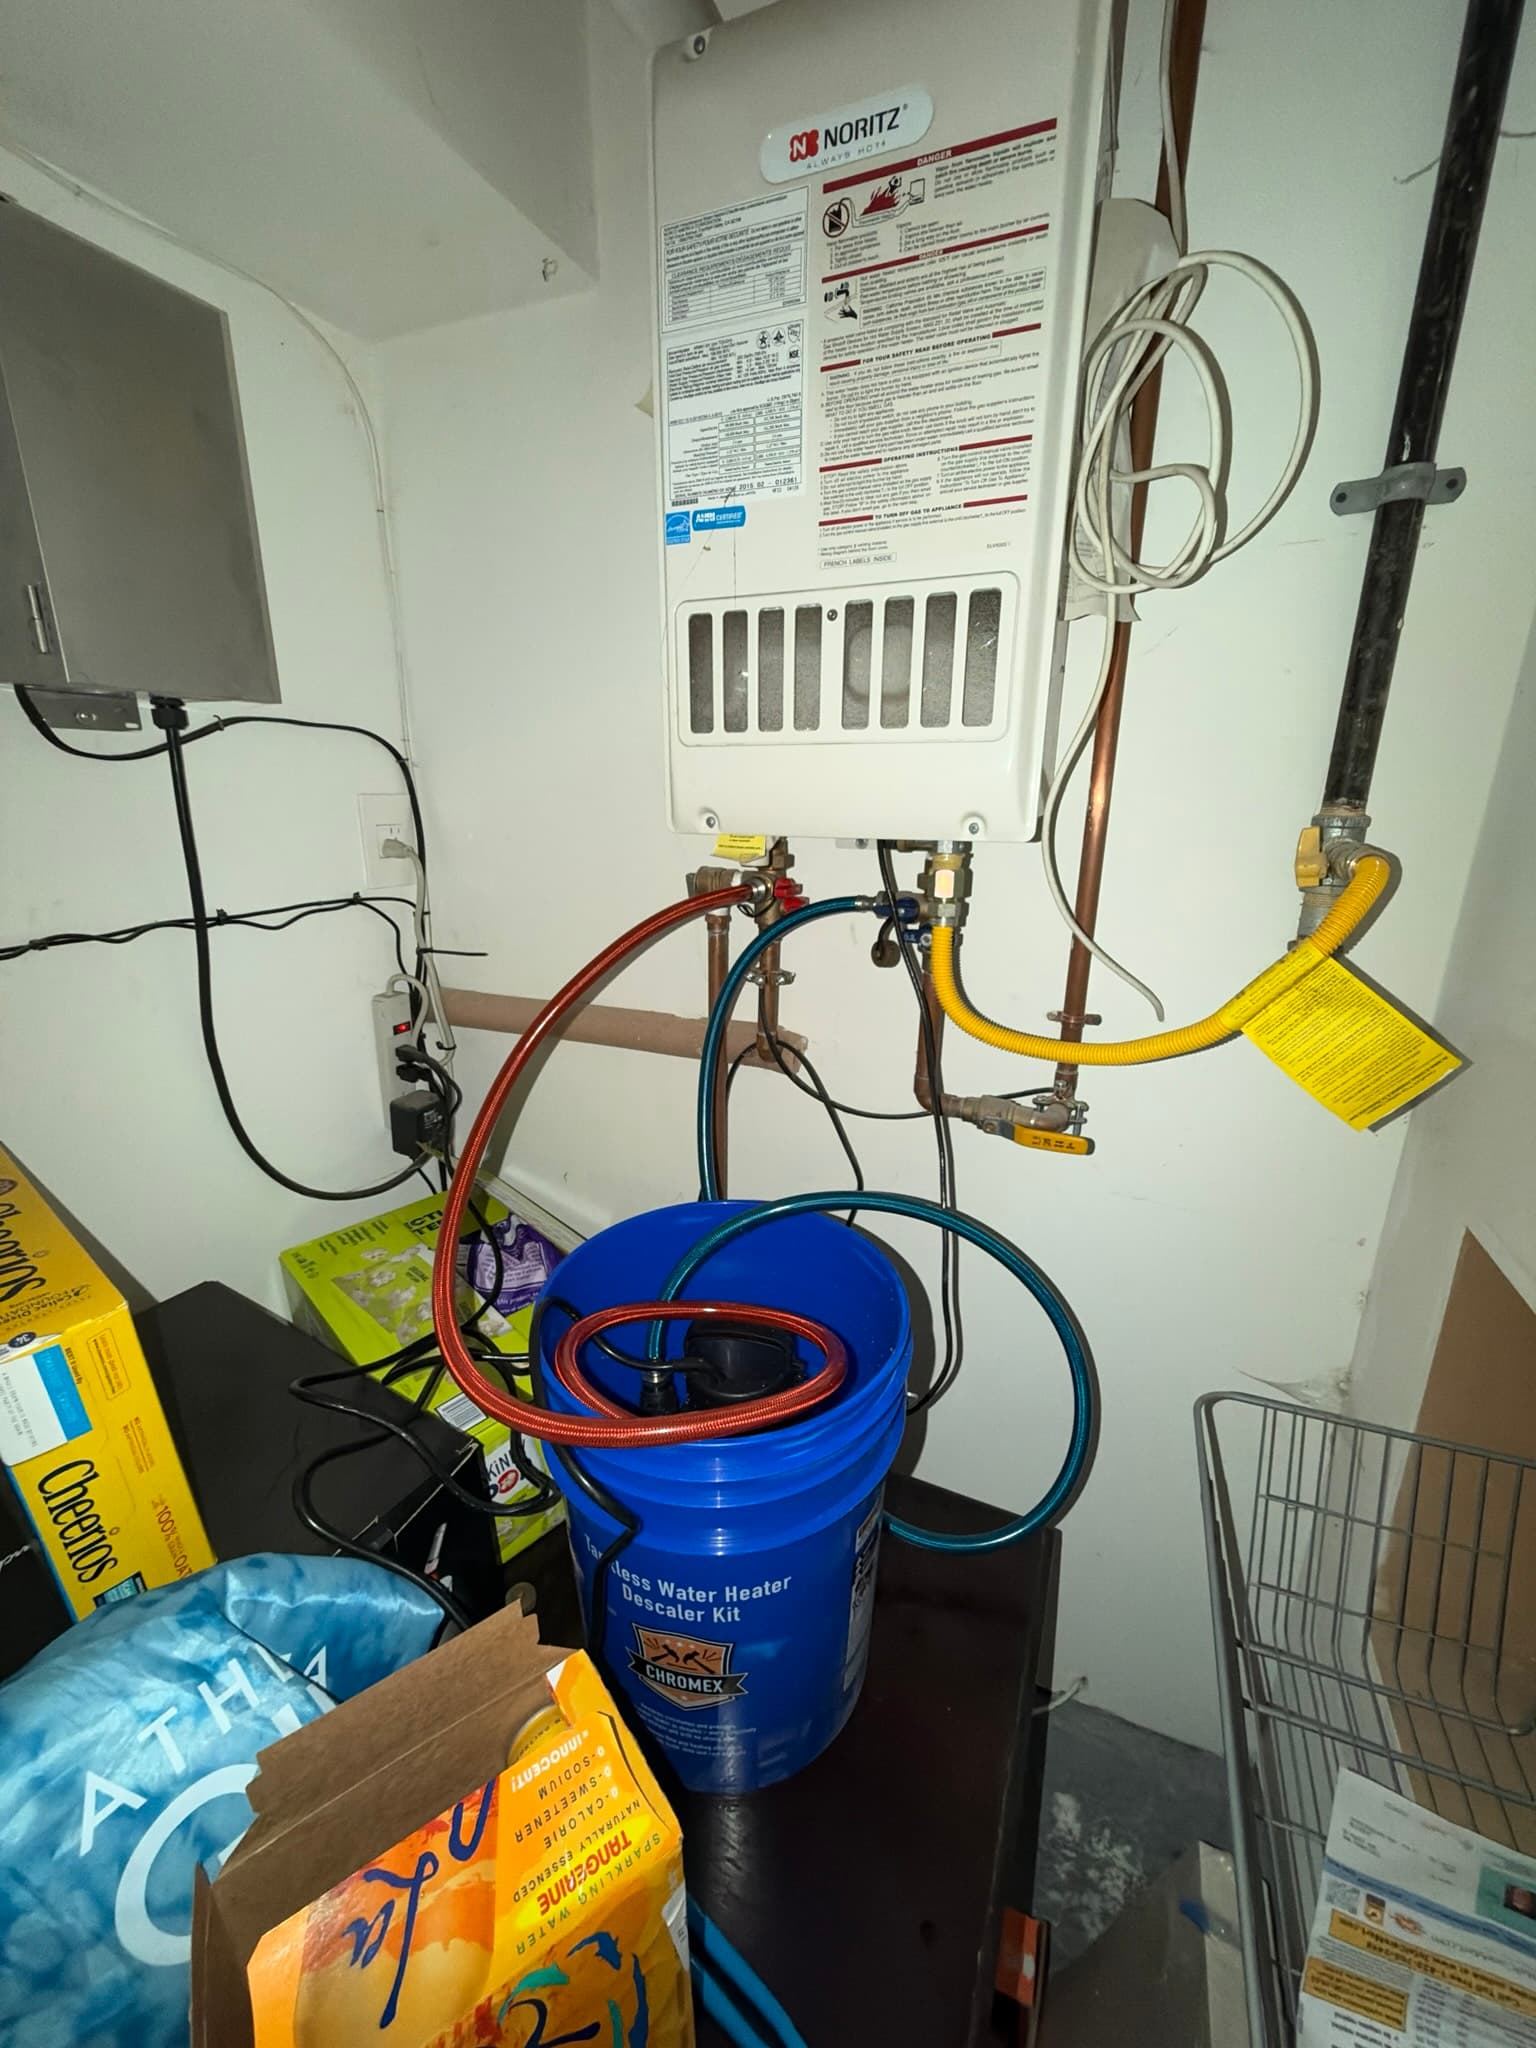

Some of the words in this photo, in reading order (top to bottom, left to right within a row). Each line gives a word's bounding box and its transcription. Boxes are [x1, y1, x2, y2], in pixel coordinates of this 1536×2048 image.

[824, 106, 901, 150] NORITZ
[806, 151, 851, 169] ALWAYS
[916, 150, 952, 167] DANGER
[862, 356, 873, 364] FOR
[874, 352, 891, 361] YOUR
[891, 348, 913, 358] SAFETY
[932, 340, 955, 350] BEFORE
[956, 333, 991, 346] OPERATING
[883, 452, 914, 462] OPERATING
[915, 445, 958, 458] INSTRUCTIONS
[882, 511, 898, 519] TURN
[899, 509, 909, 517] OFF
[923, 506, 931, 514] TO
[931, 503, 962, 513] APPLIANCE
[823, 559, 847, 568] FRENCH
[848, 556, 870, 565] LABELS
[873, 554, 892, 563] INSIDE
[38, 1459, 120, 1583] Cheerios
[157, 1506, 177, 1543] 100%
[622, 1583, 705, 1623] Descaler
[713, 1607, 741, 1623] Kit
[657, 1579, 717, 1603] Water
[725, 1576, 792, 1603] Heater
[645, 1664, 723, 1693] CHROMEX
[511, 1739, 583, 1793] INNOCENT!
[578, 1800, 641, 1853] NATURALLY
[513, 1850, 574, 1903] ESSENCED
[536, 1830, 633, 1916] TANGERINE
[577, 1833, 661, 1906] SPARKLING
[342, 1851, 439, 2029] La
[517, 1906, 571, 1955] WATER
